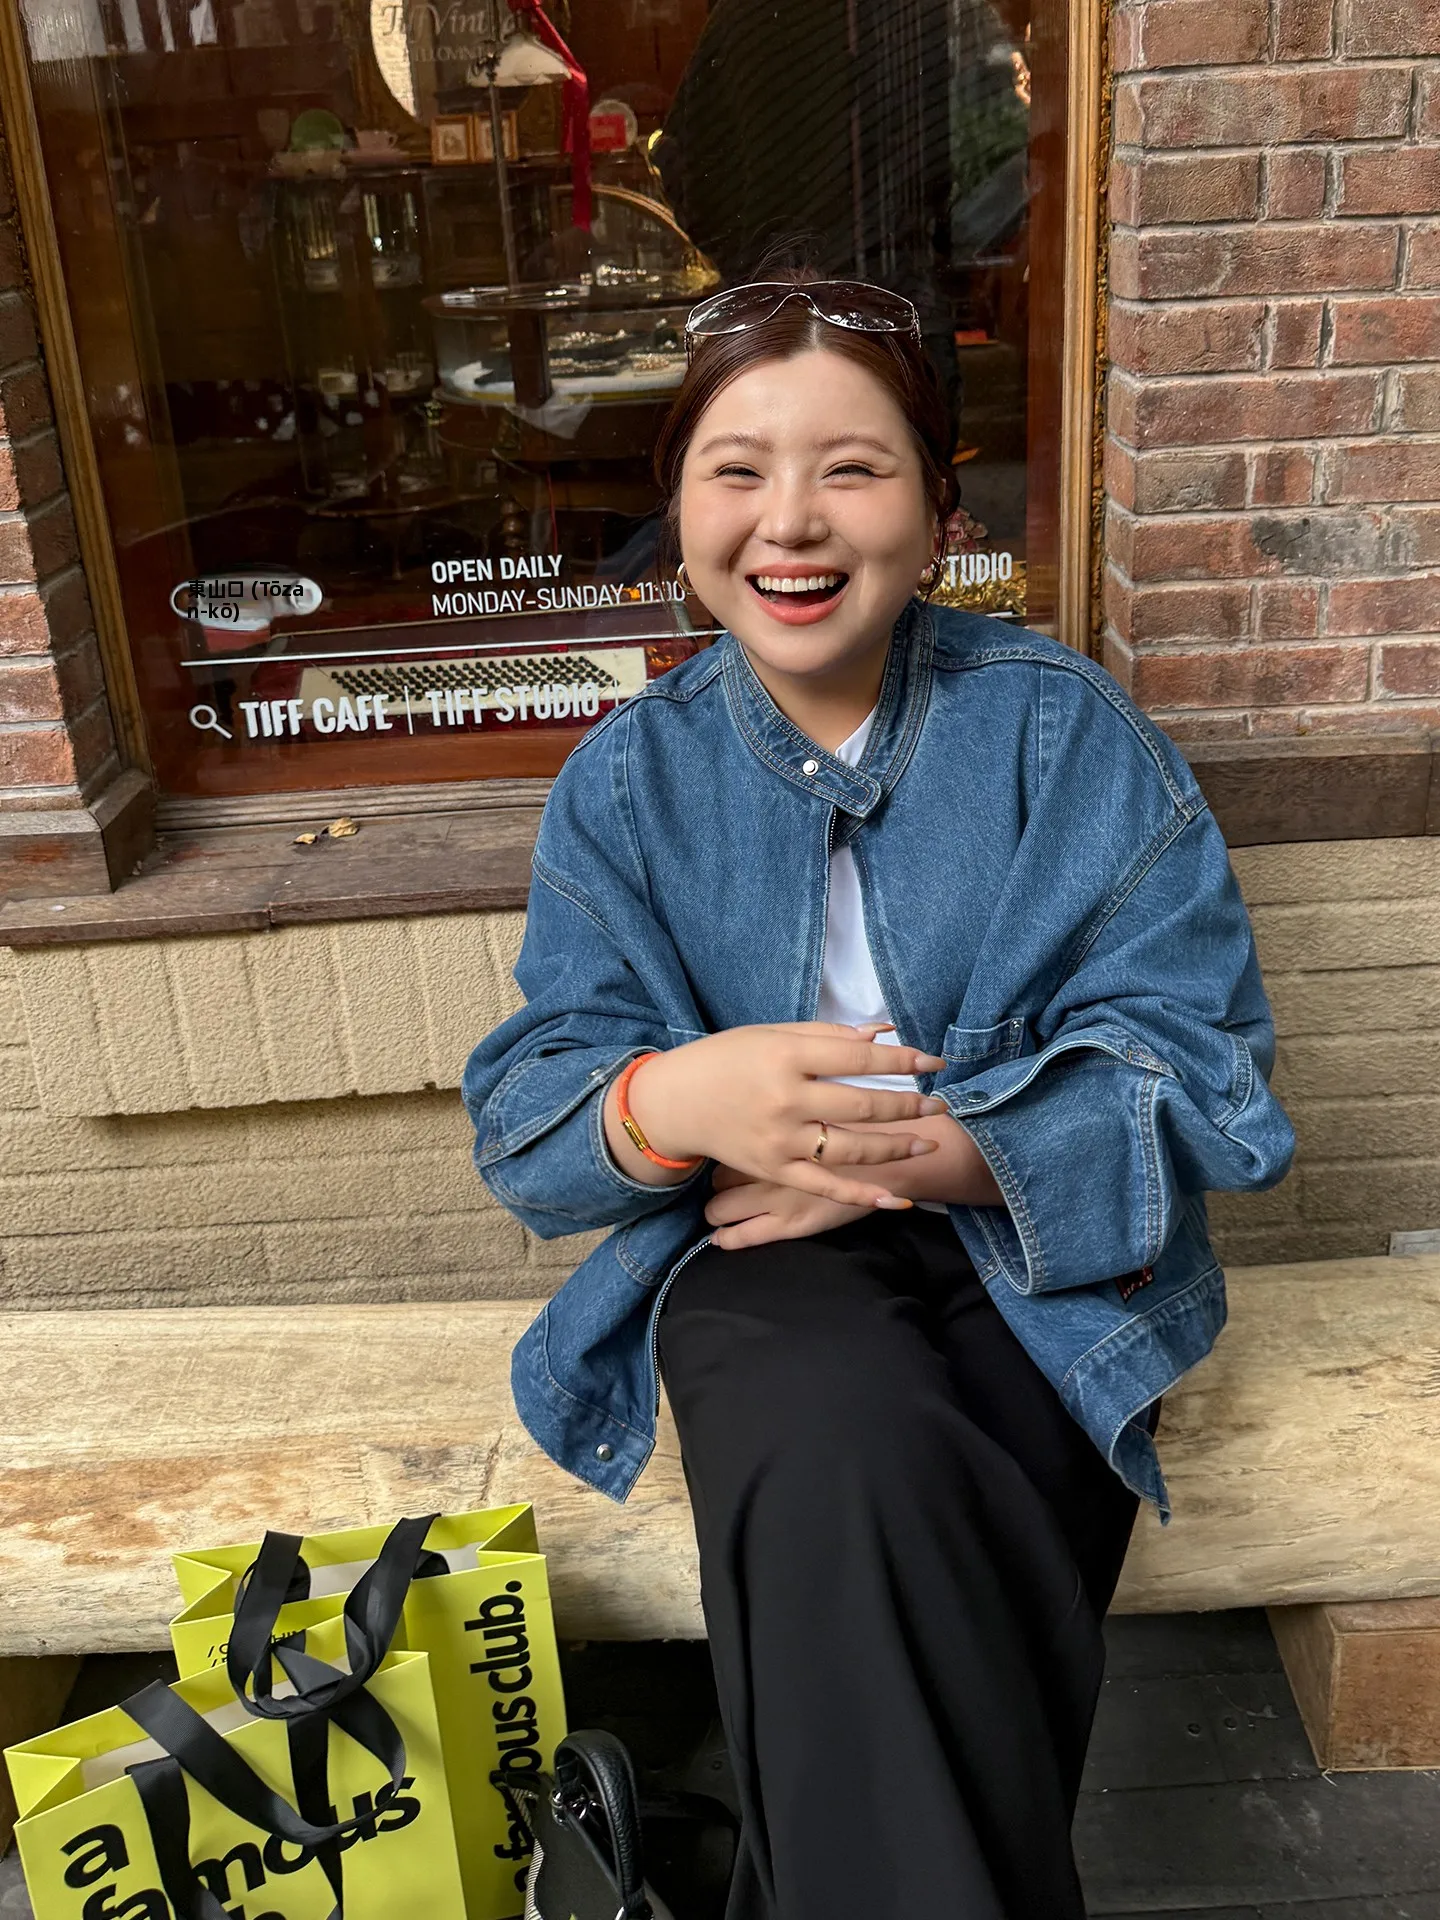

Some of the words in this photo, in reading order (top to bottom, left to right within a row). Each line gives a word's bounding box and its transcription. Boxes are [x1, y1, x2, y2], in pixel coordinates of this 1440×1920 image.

[431, 558, 493, 583] OPEN
[500, 554, 563, 580] DAILY
[945, 551, 1013, 588] TUDIO
[431, 583, 625, 617] MONDAY-SUNDAY
[238, 699, 304, 738] TIFF
[312, 693, 394, 734] CAFE
[425, 687, 488, 727] TIFF
[494, 681, 600, 723] STUDIO
[464, 1580, 533, 1694] club.
[494, 1696, 543, 1861] faous
[59, 1823, 130, 1889] a
